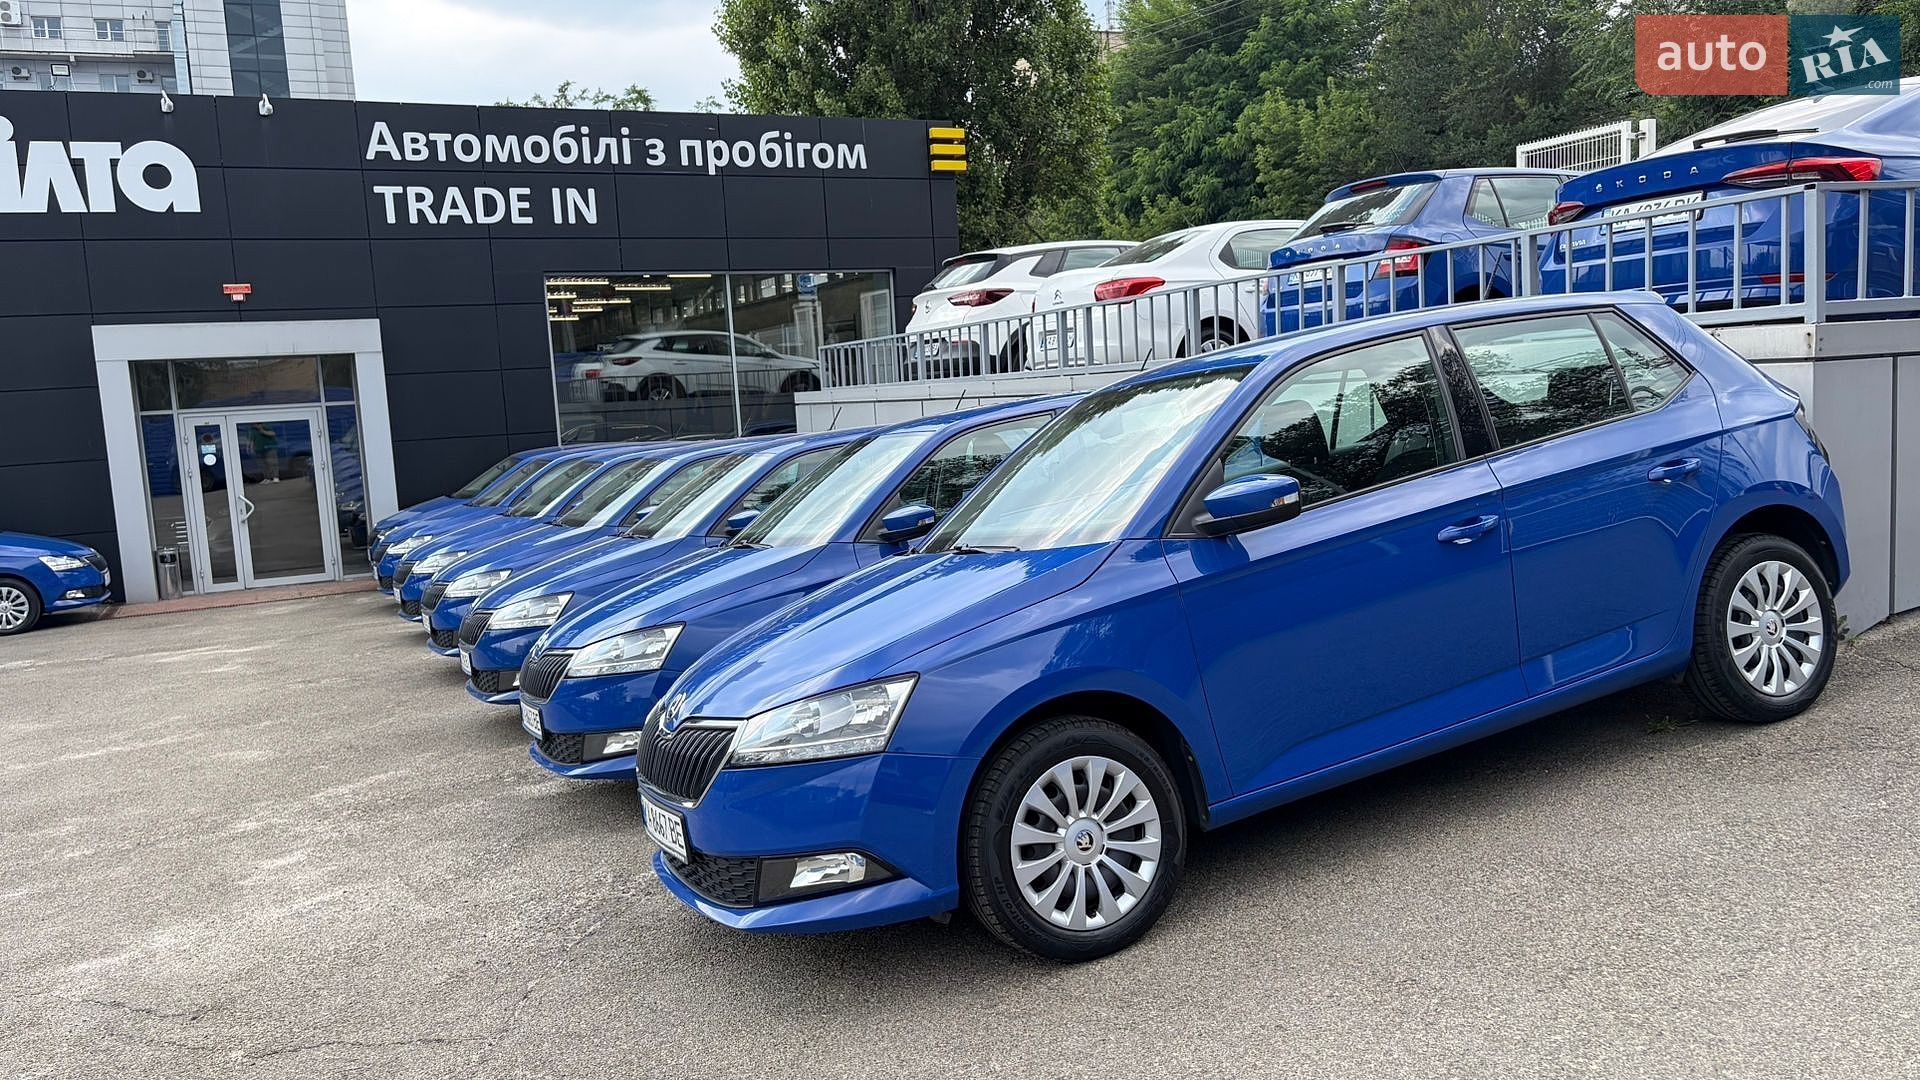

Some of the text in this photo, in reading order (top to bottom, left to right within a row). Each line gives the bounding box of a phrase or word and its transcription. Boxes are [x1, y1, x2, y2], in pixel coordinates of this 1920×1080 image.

[365, 121, 868, 176] Автомобілі з пробігом
[373, 185, 598, 225] TRADE IN
